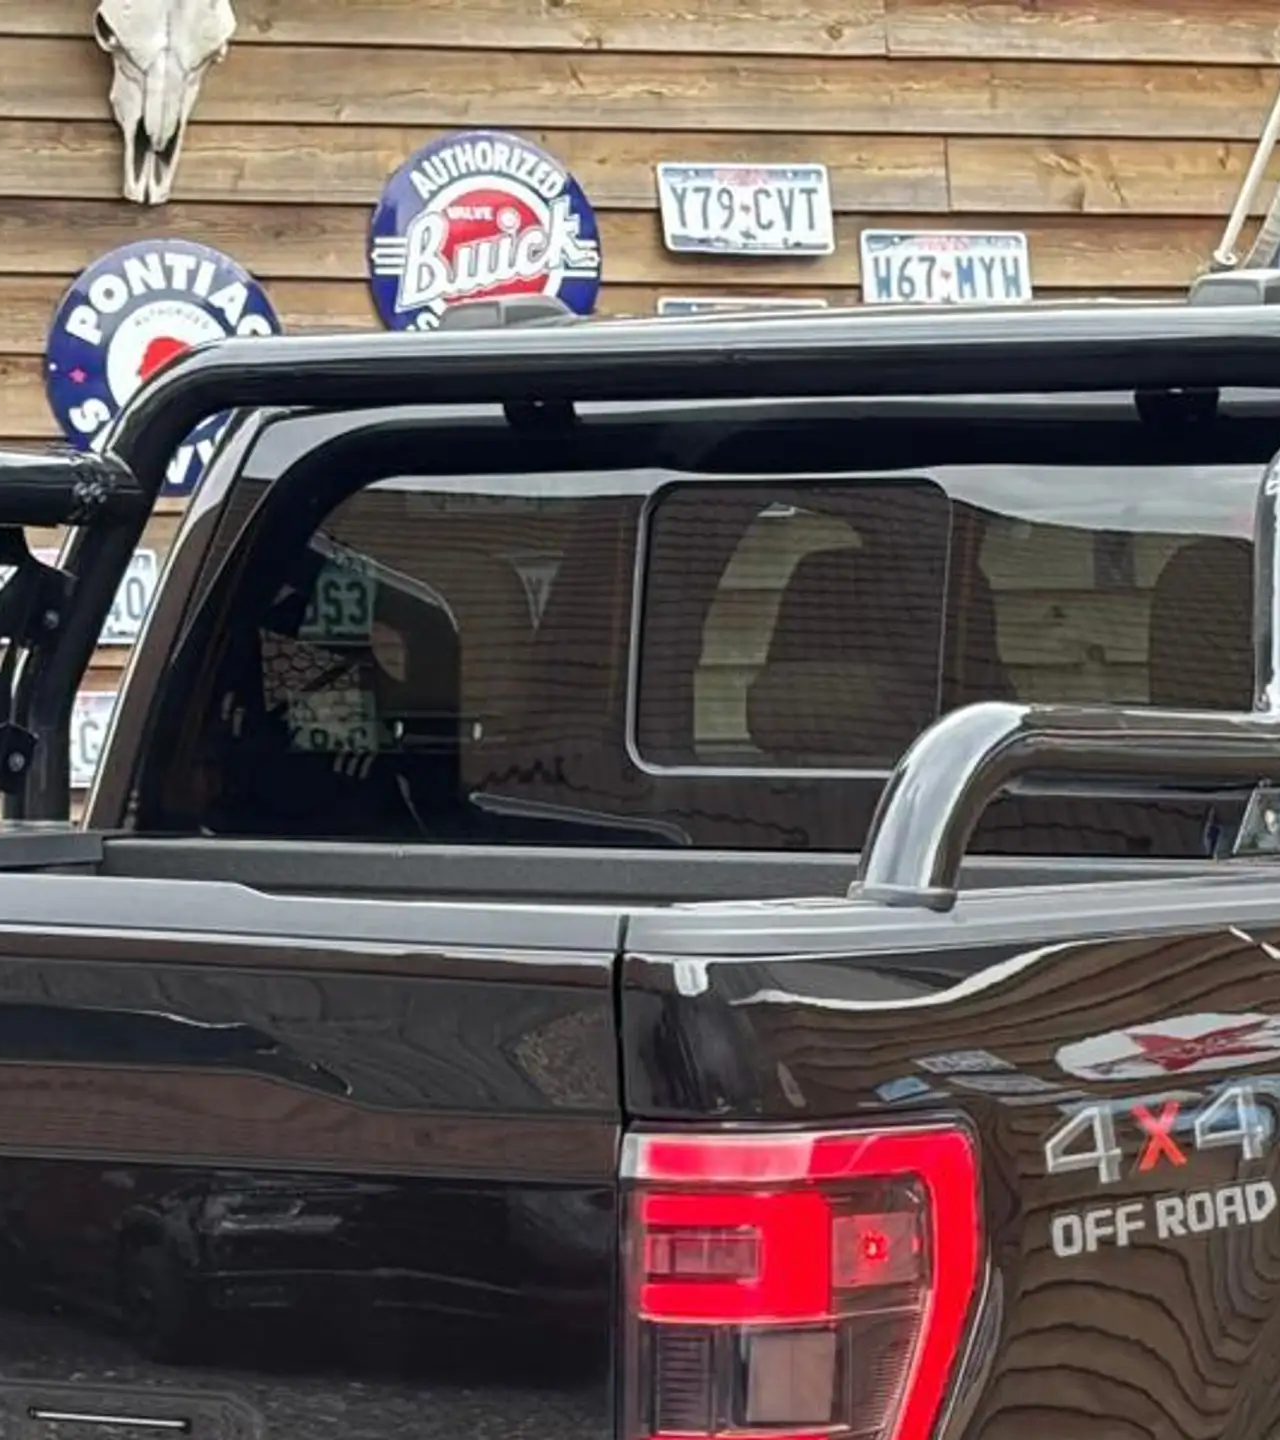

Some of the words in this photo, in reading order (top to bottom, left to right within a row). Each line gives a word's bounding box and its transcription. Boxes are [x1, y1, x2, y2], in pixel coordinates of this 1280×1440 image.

[409, 140, 569, 200] AUTHORIZED
[395, 195, 600, 313] Buick
[1051, 1202, 1146, 1258] OFF
[1156, 1181, 1278, 1239] ROAD
